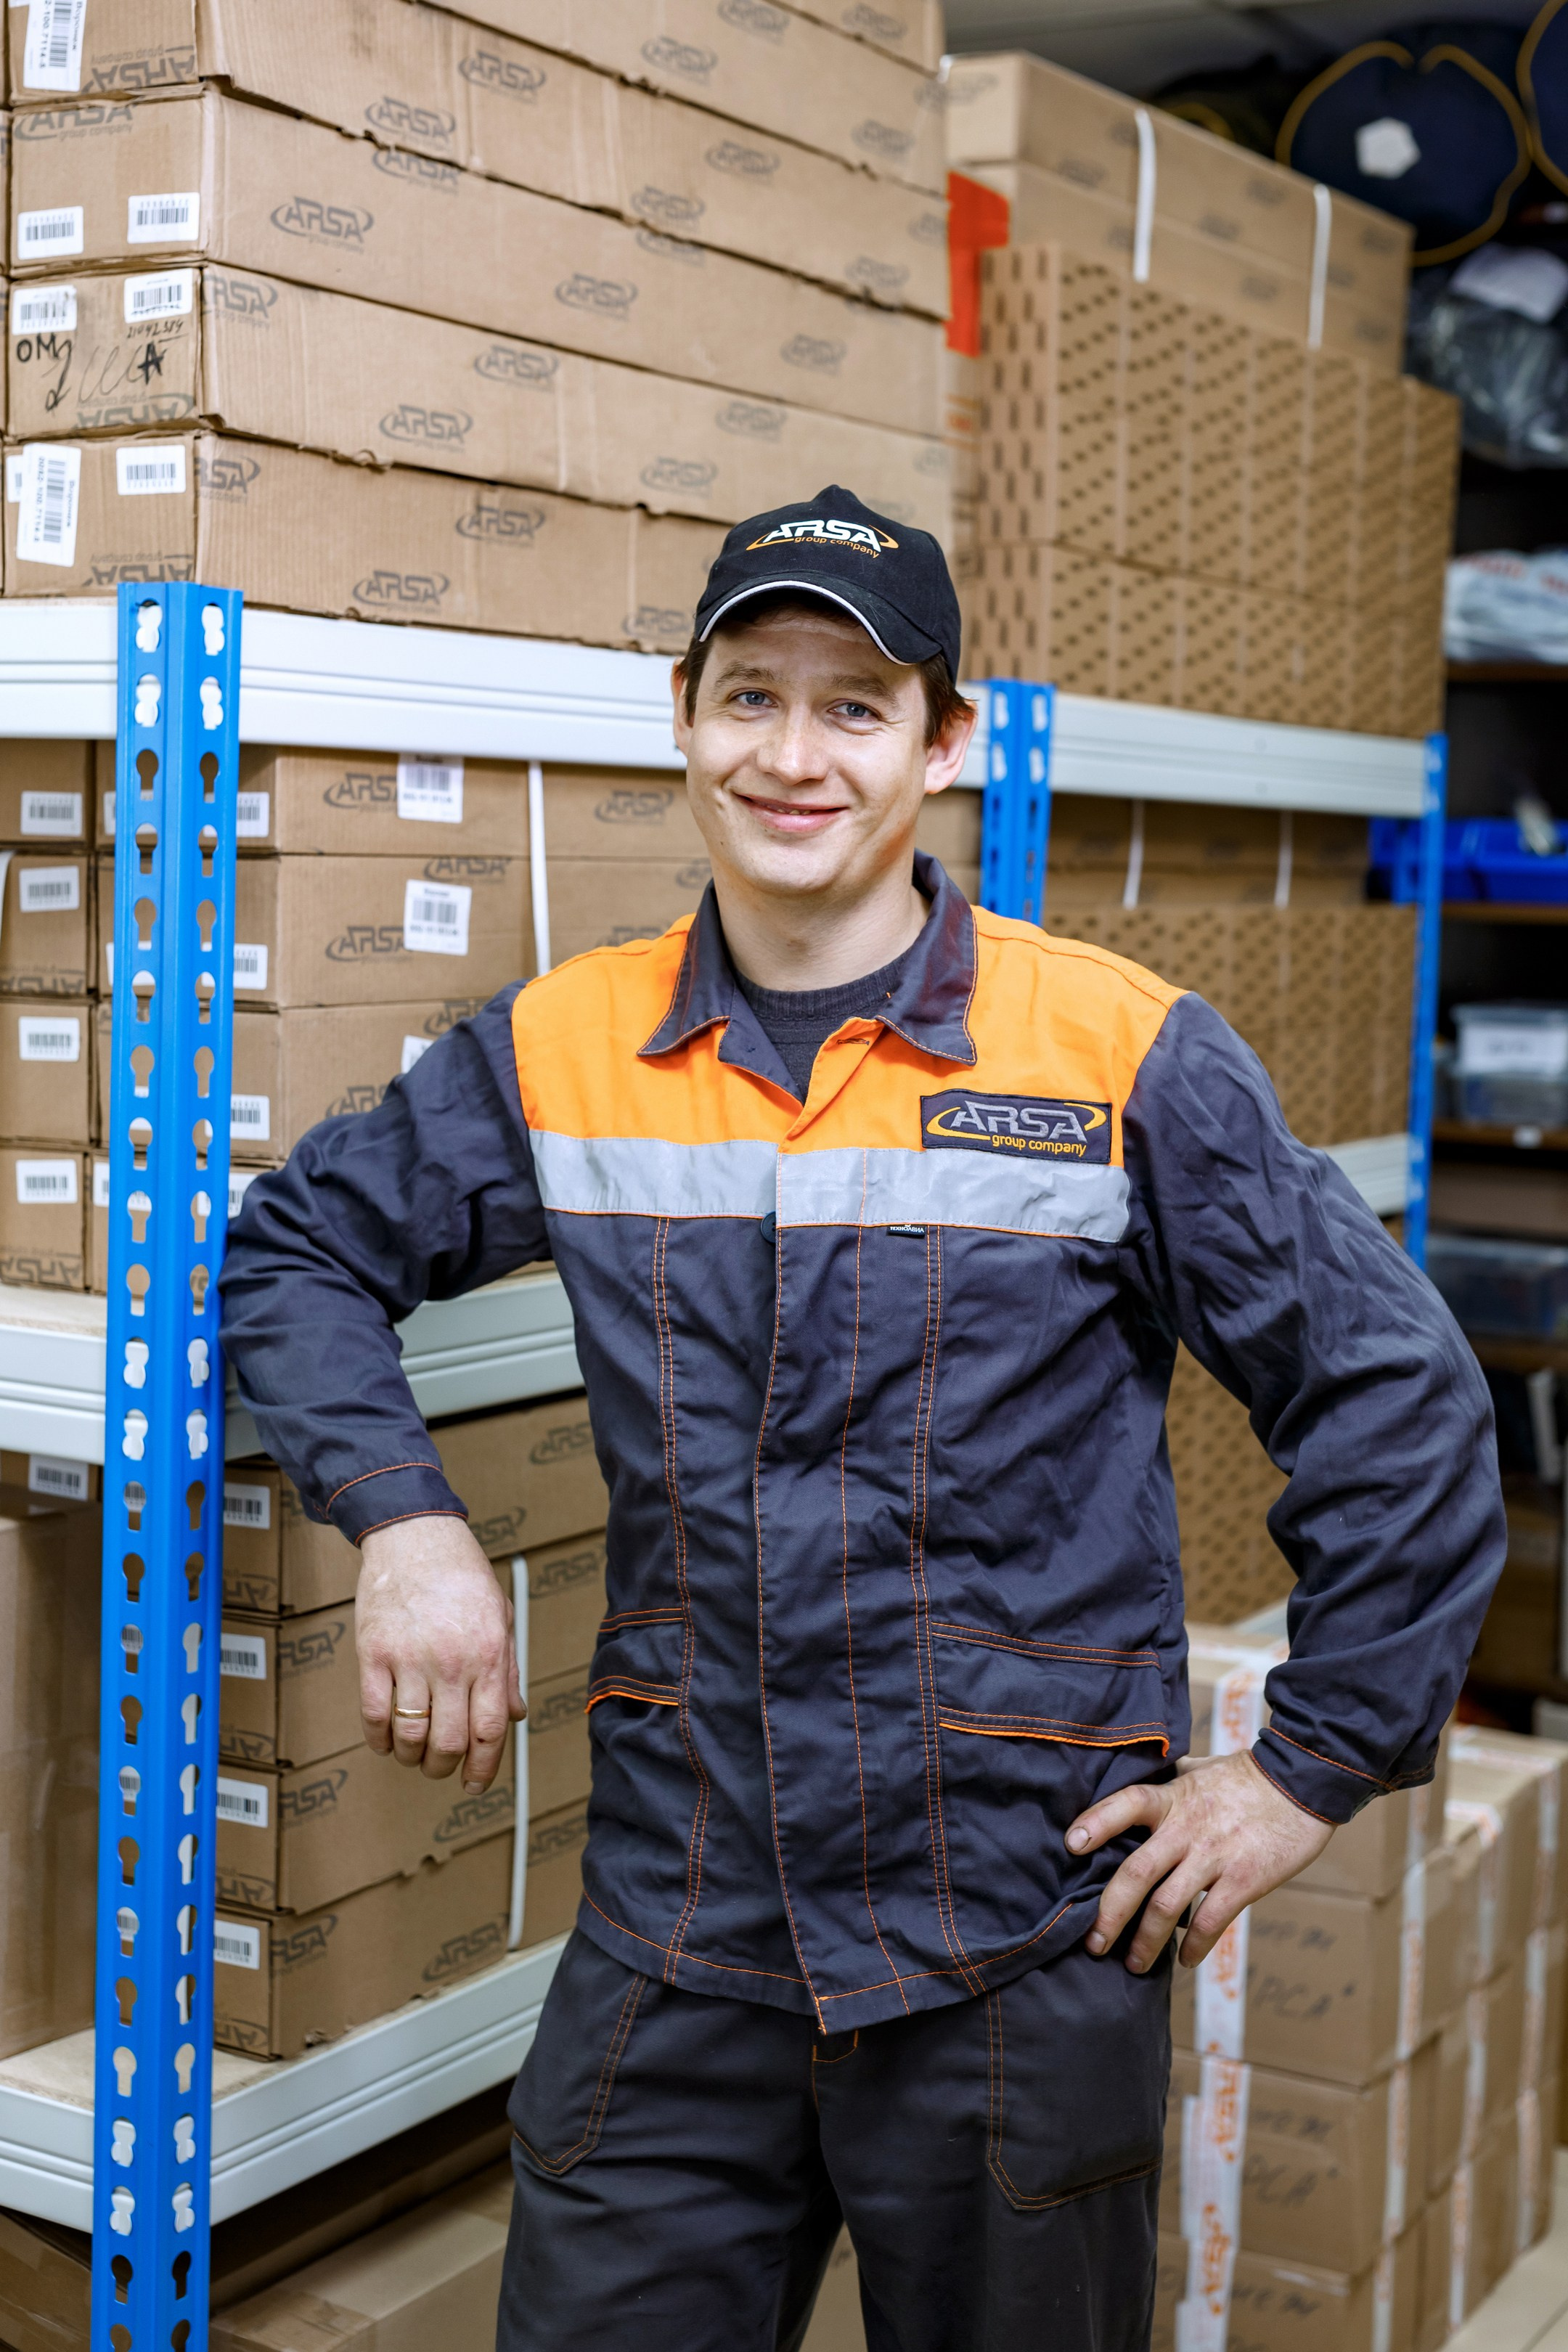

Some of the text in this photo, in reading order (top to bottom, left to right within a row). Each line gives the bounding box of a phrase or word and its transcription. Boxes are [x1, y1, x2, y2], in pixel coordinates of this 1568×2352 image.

[377, 96, 450, 144] ARSA
[285, 196, 364, 243] ARSA
[391, 404, 465, 444] ARSA
[194, 457, 248, 494] RSA
[467, 505, 535, 539] ARSA
[762, 519, 881, 552] ARSA
[830, 539, 880, 559] company
[365, 570, 441, 605] ARSA
[950, 1101, 1088, 1143] ARSA
[992, 1135, 1087, 1156] group company
